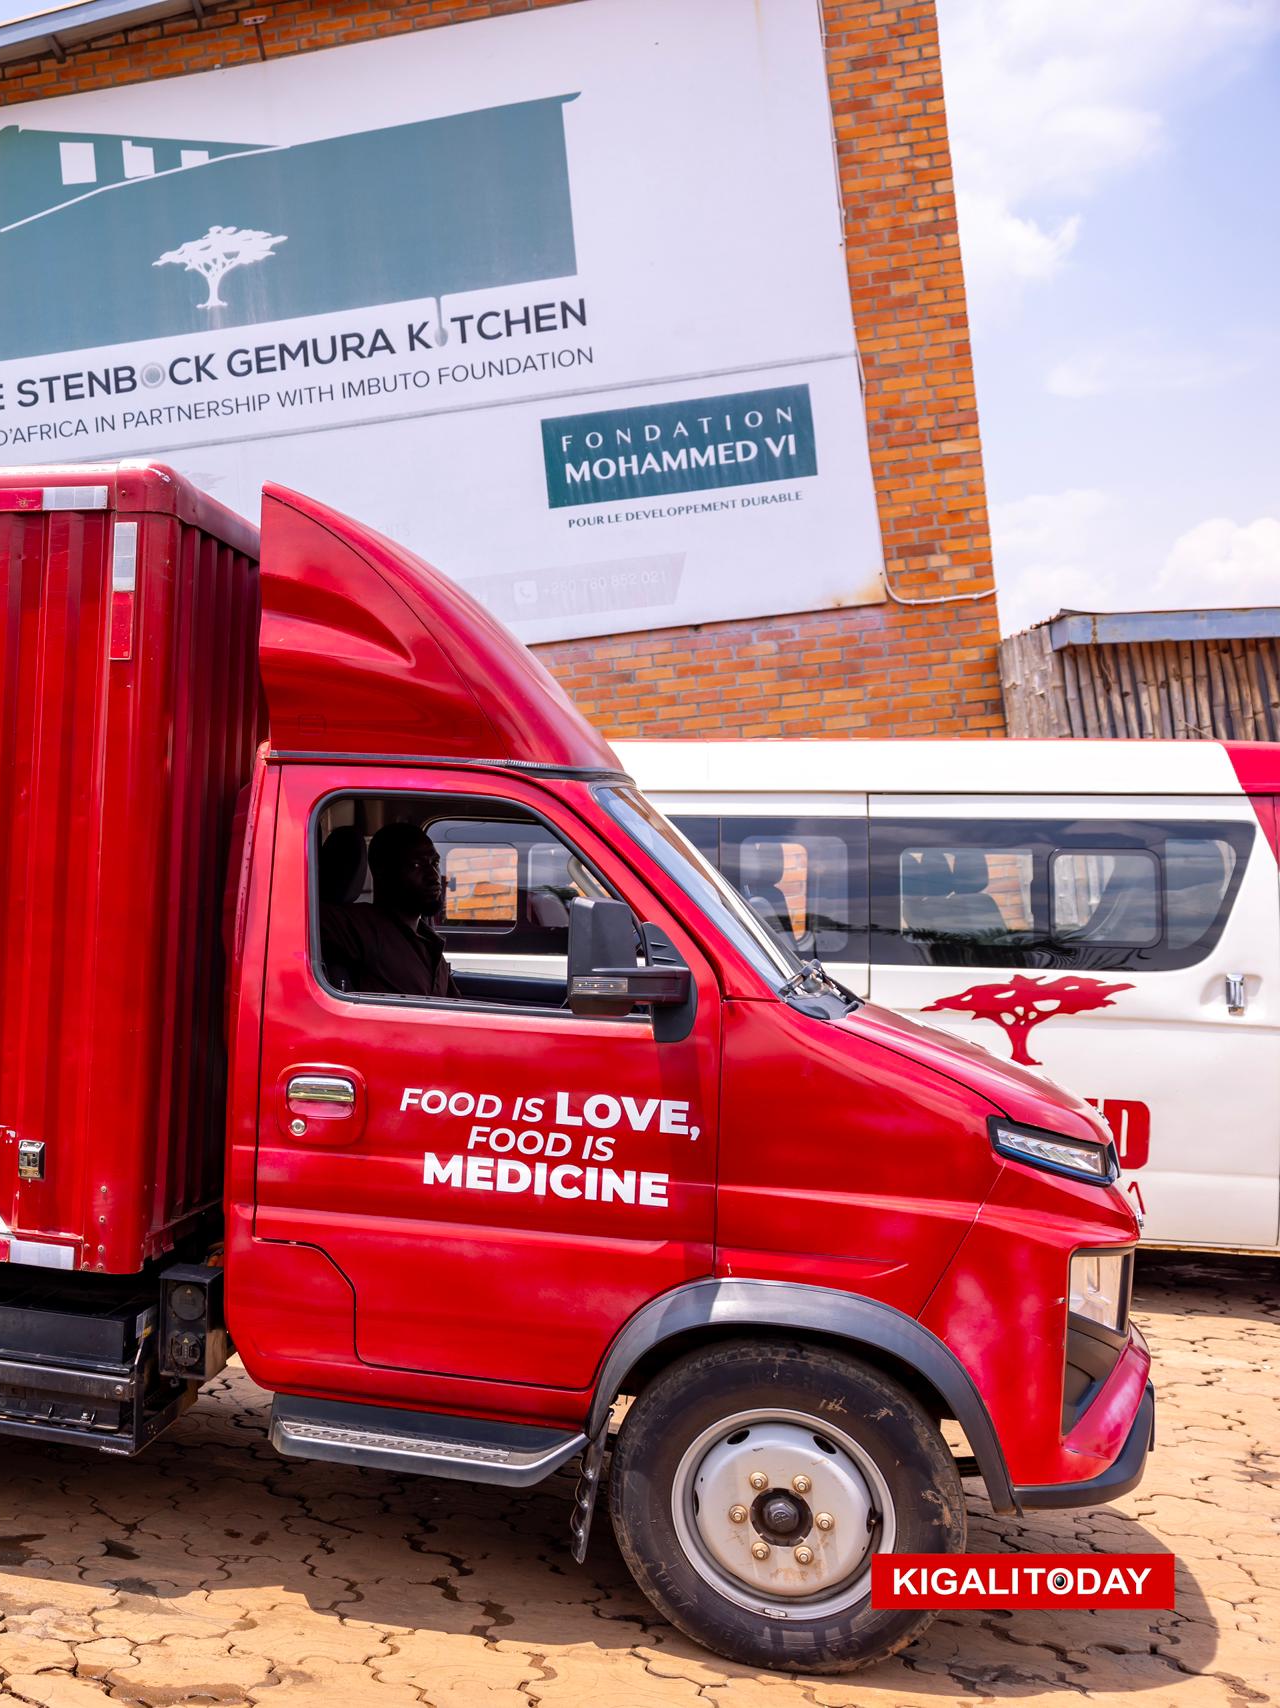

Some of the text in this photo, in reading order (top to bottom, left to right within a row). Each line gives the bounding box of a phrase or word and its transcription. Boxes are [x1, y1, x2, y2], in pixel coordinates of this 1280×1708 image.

[227, 328, 396, 377] GEMURA
[95, 414, 116, 433] IN
[122, 393, 270, 429] PARTNERSHIP
[277, 384, 334, 408] WITH
[341, 370, 430, 399] IMBUTO
[438, 347, 594, 385] FOUNDATION
[561, 406, 793, 452] FONDATION
[565, 434, 797, 483] MOHAMMED VI
[568, 490, 803, 528] POUR LE DEVELOPPEMENT DURABLE
[399, 1088, 701, 1141] FOOD IS LOVE,
[467, 1125, 616, 1162] FOOD IS
[423, 1152, 669, 1207] MEDICINE
